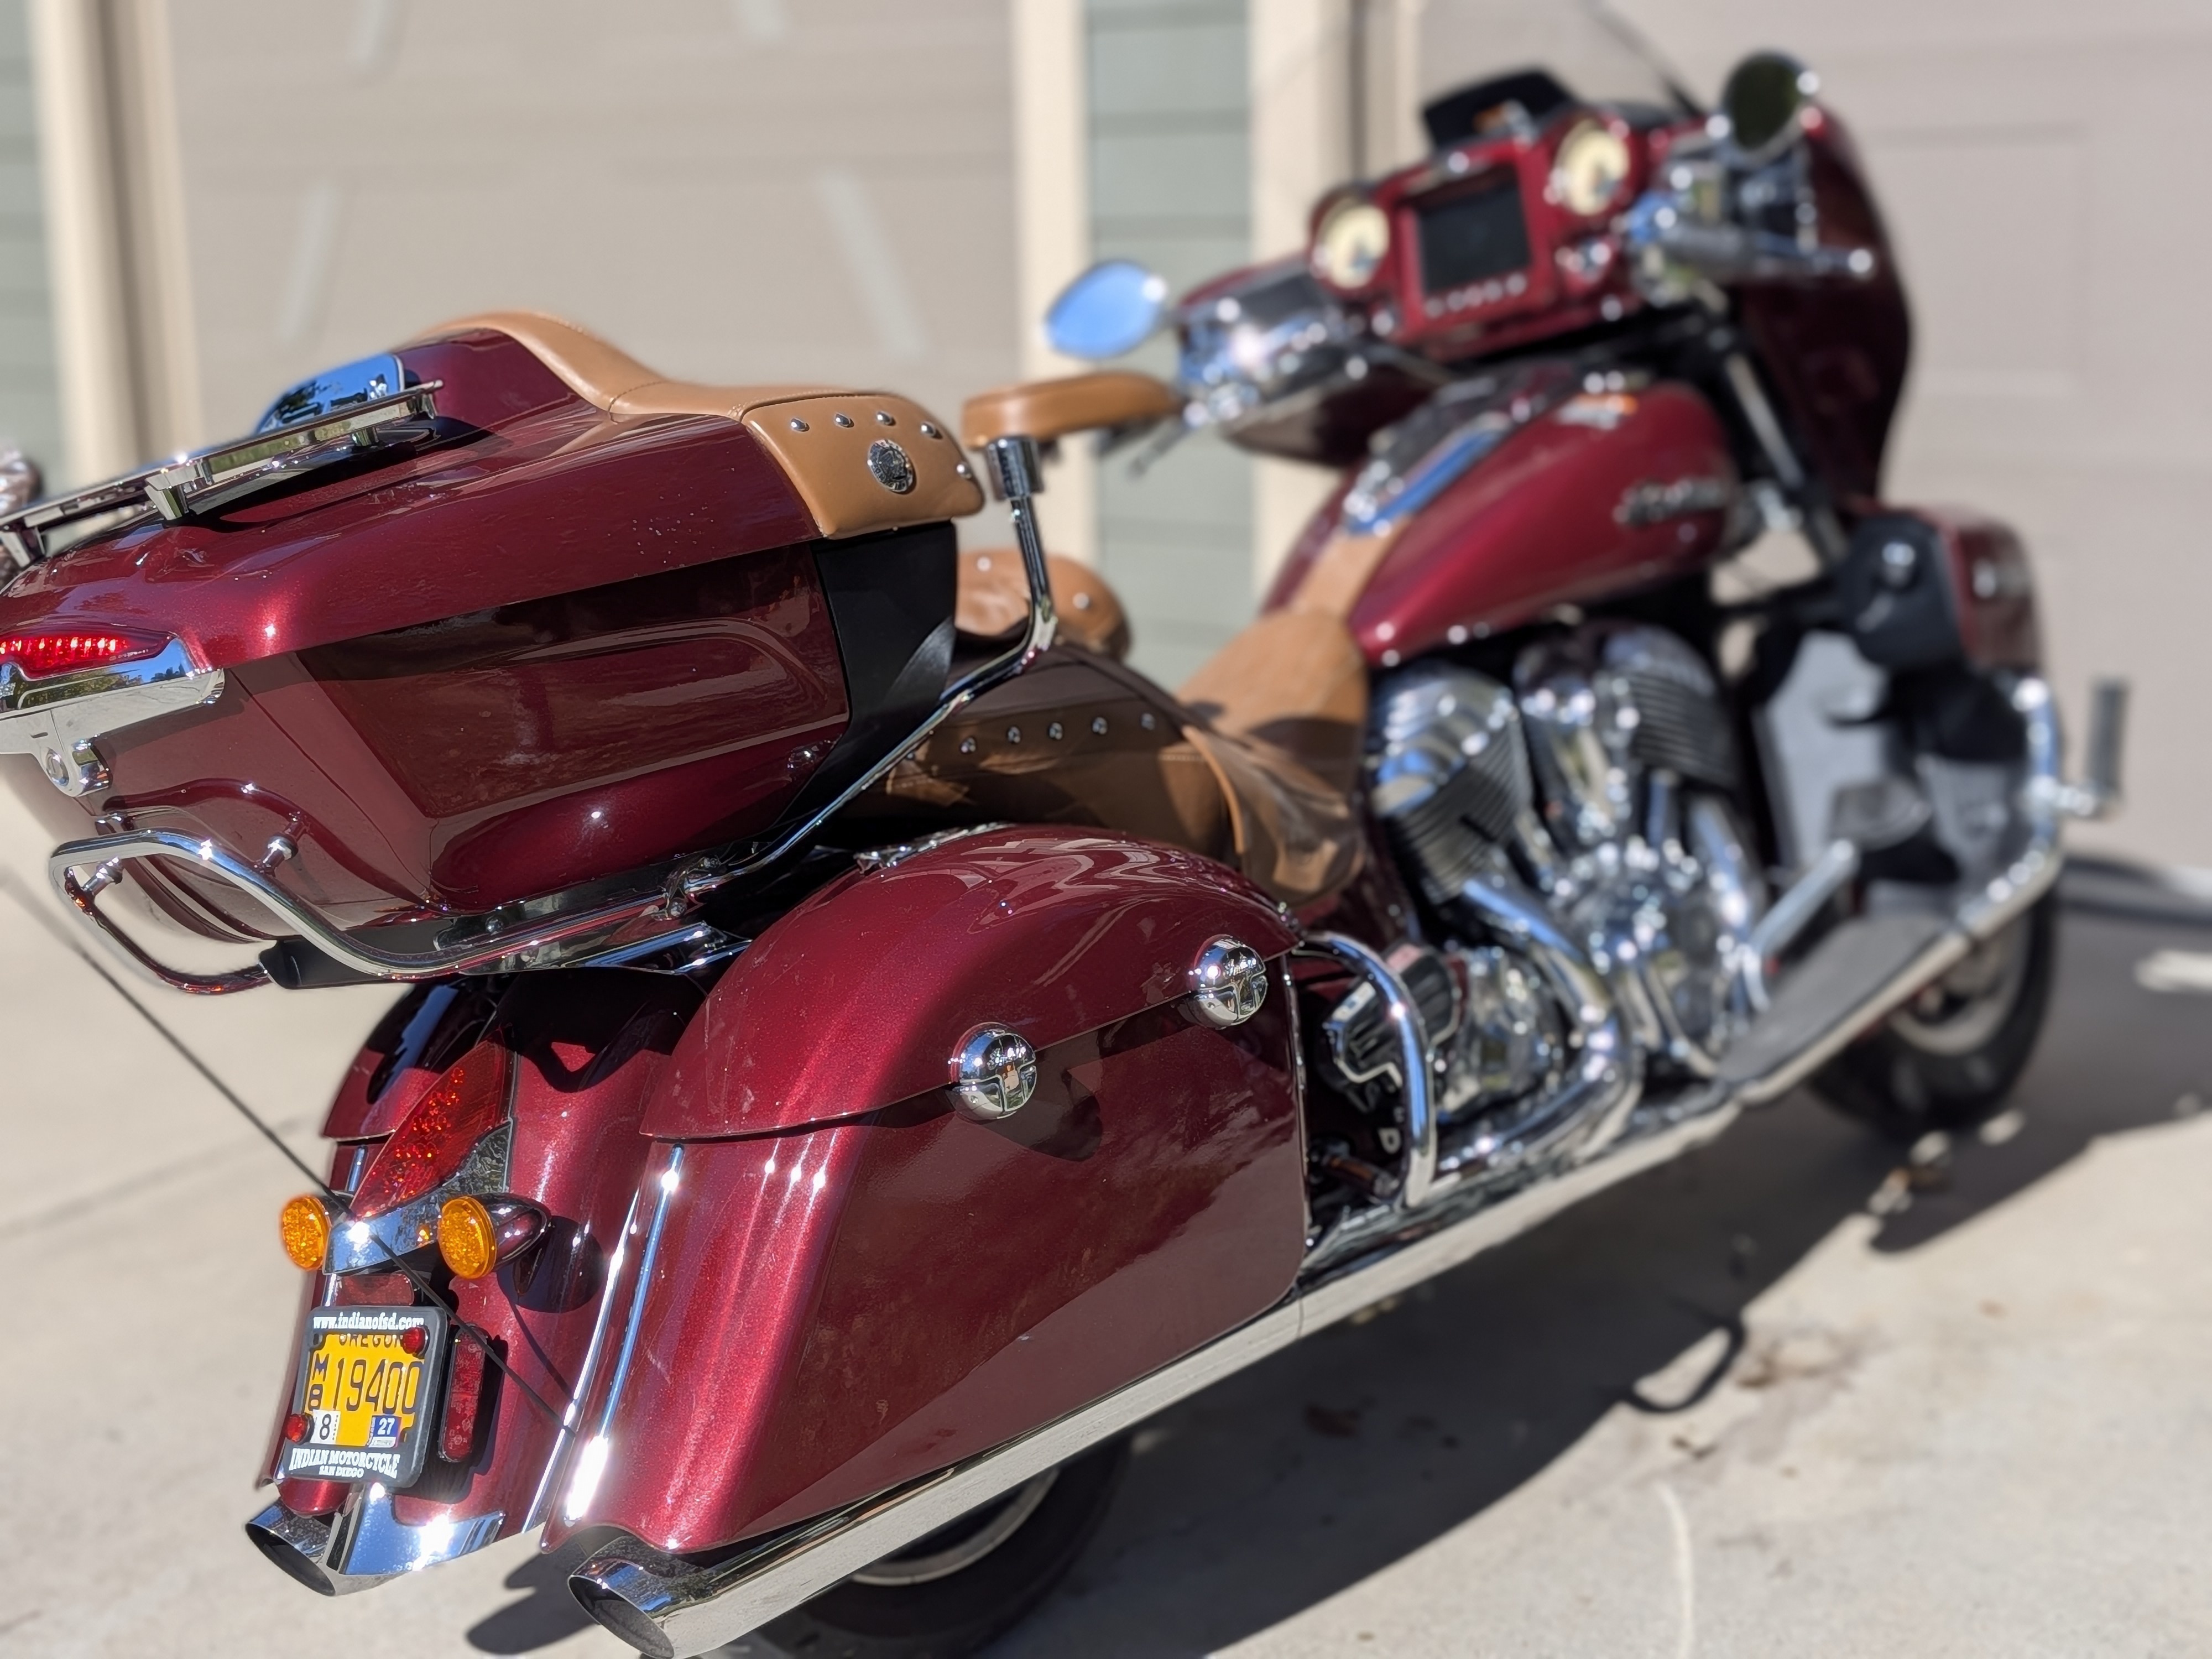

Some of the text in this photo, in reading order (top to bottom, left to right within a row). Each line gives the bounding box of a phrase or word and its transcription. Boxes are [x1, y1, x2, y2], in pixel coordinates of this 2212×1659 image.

[313, 1312, 424, 1330] www.indianofsd.com
[333, 1358, 425, 1415] 19400
[319, 1413, 332, 1441] 8
[377, 1417, 395, 1435] 27
[289, 1448, 401, 1479] INDIAN MOTORCYCLE
[319, 1465, 364, 1478] SAN DIEGO
